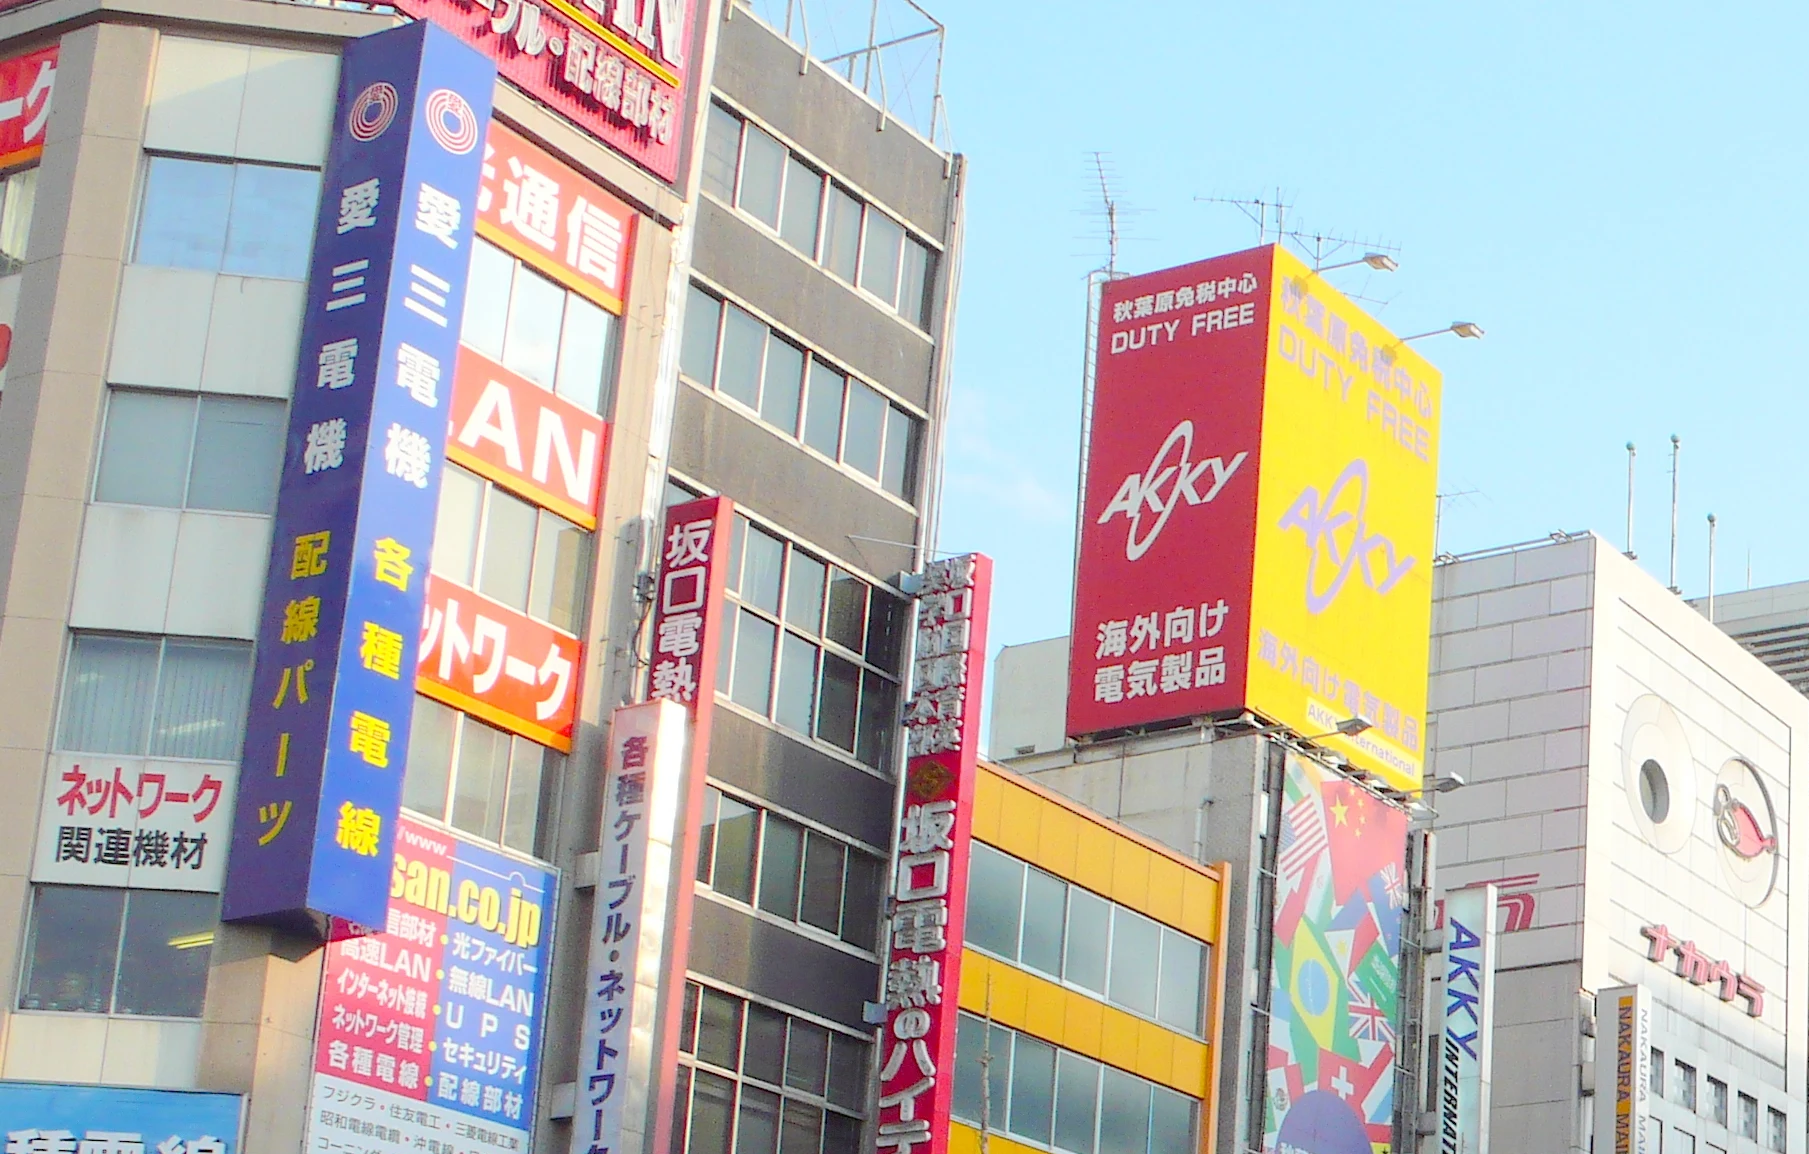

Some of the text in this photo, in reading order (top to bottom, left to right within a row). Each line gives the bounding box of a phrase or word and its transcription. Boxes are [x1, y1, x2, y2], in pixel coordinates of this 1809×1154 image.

[303, 177, 381, 474] 愛三電機
[384, 182, 462, 489] 愛三電機
[1110, 303, 1255, 355] DUTY FREE
[1113, 272, 1258, 323] 秋葉原免税中心
[1280, 275, 1432, 417] 秋葉原免税中心
[447, 378, 596, 506] AN
[1278, 325, 1431, 462] DUTY FREE
[652, 518, 713, 703] 坂口電熱
[1094, 600, 1229, 659] 海外向け
[258, 531, 331, 848] 配線パーツ
[336, 537, 414, 857] 各種電線
[1094, 646, 1227, 704] 電気製品
[1257, 628, 1420, 751] 海外向け電気製品
[1307, 702, 1338, 732] AKK
[56, 764, 223, 824] ネットワーク
[54, 826, 208, 870] 関連機材
[449, 965, 535, 1017] 無線LAN
[1446, 917, 1480, 1061] AKKY
[1640, 922, 1767, 1019] ナカウラ
[328, 1039, 525, 1120] 各種電線 配線部材
[443, 1037, 528, 1083] セキュリティ
[1616, 1005, 1633, 1111] NAKAURA
